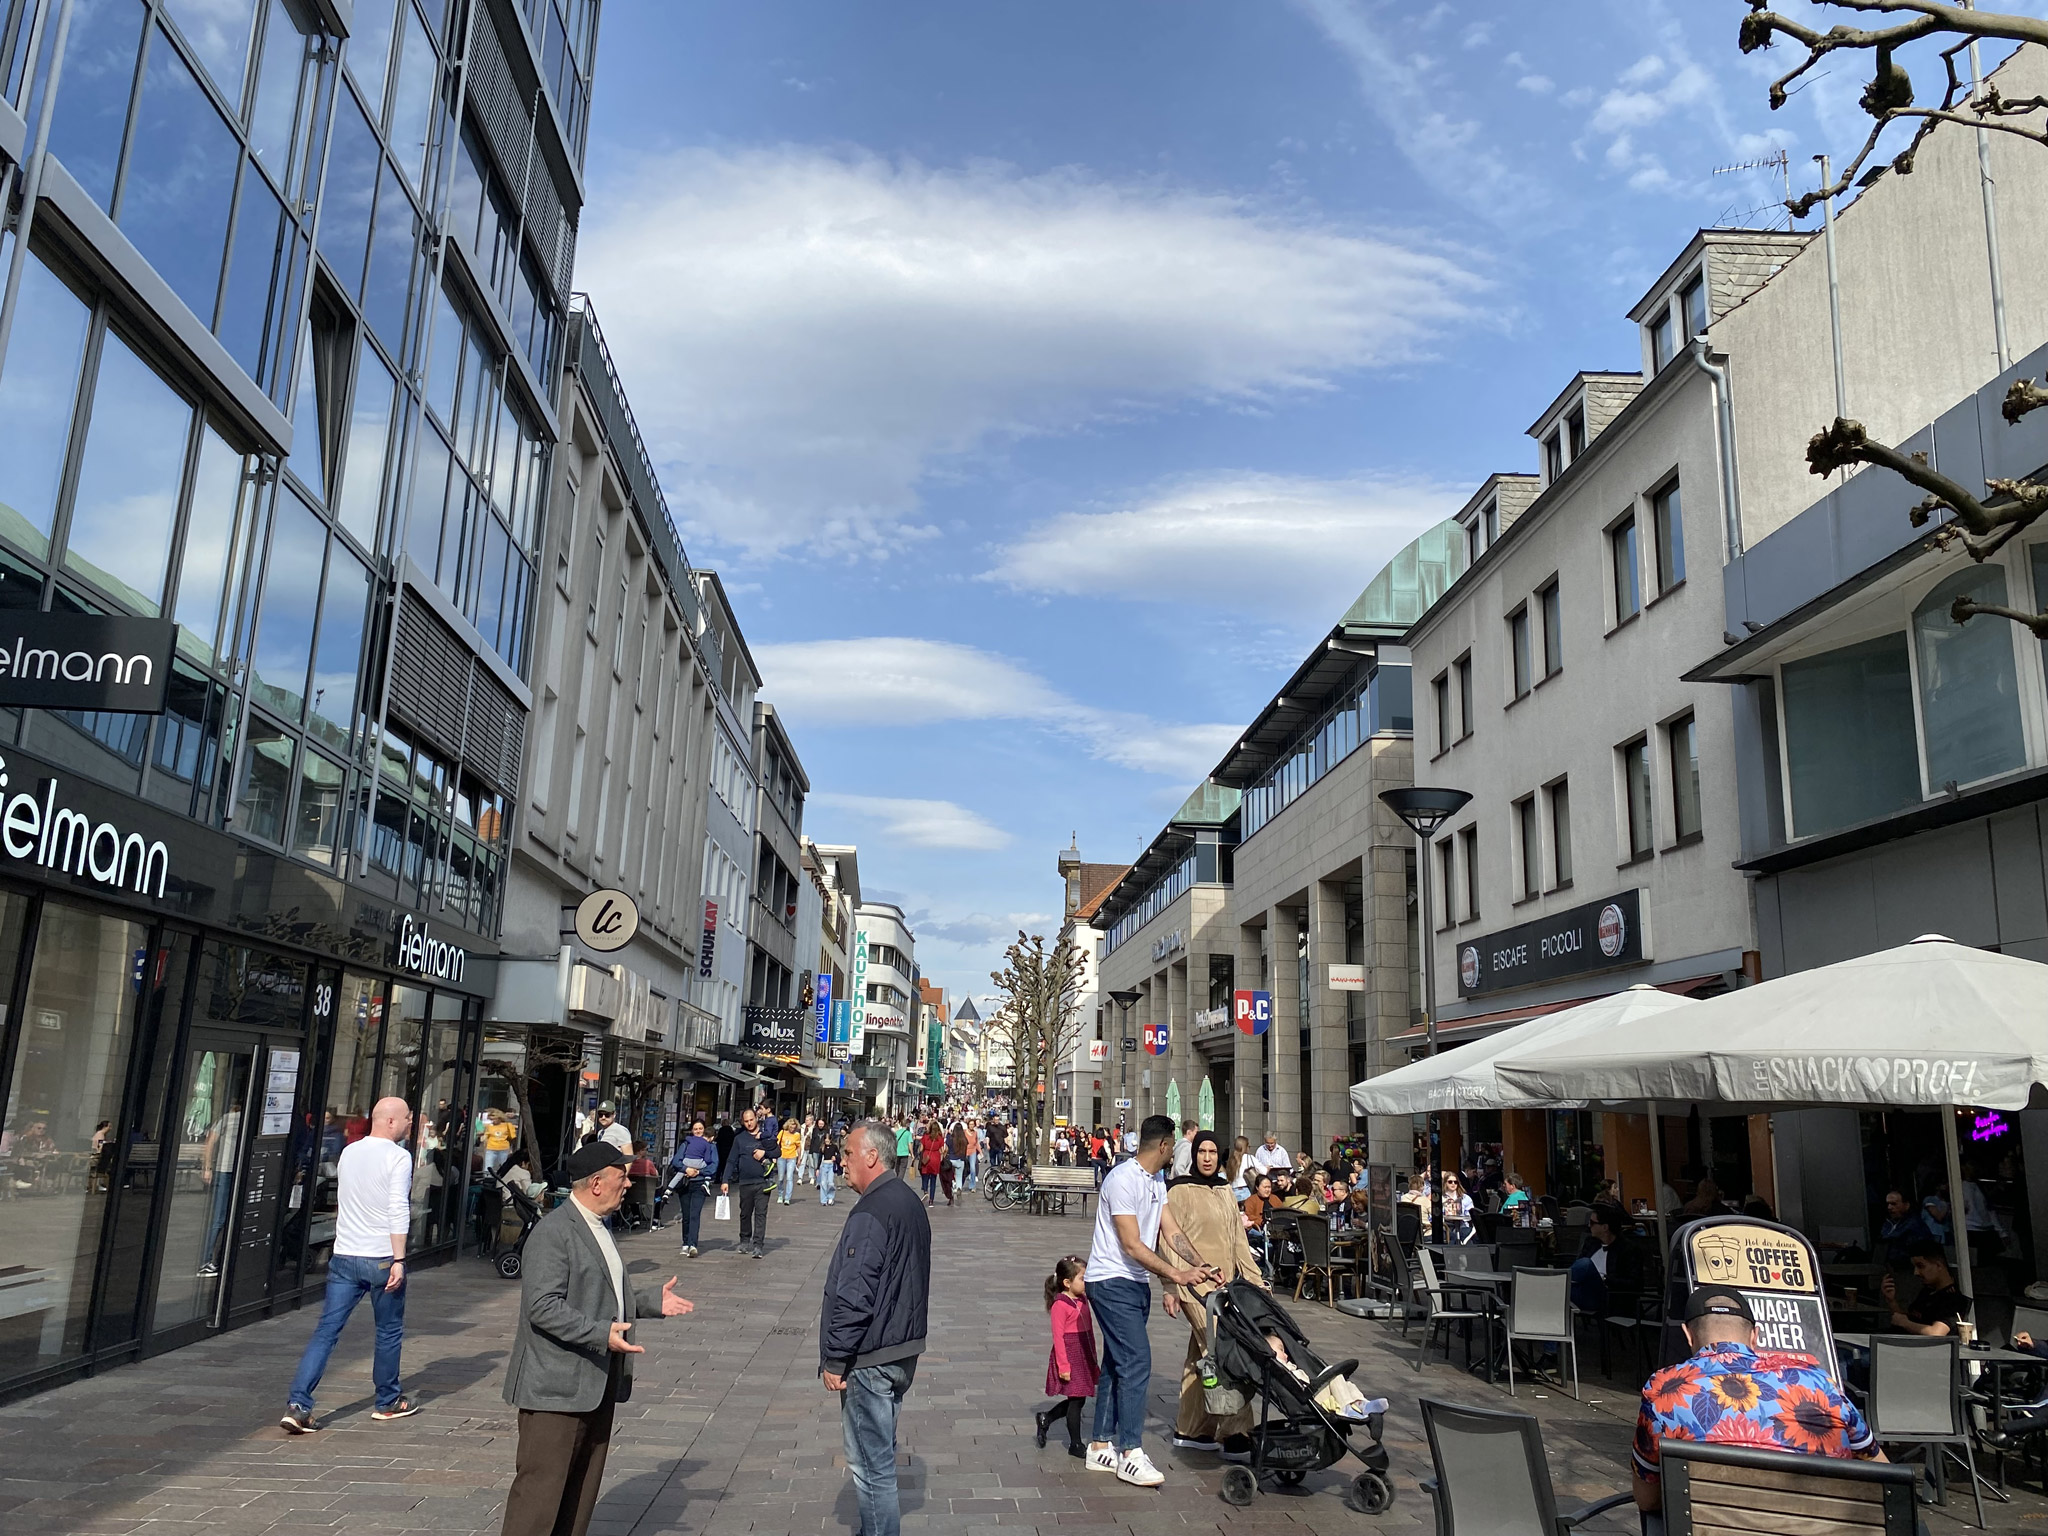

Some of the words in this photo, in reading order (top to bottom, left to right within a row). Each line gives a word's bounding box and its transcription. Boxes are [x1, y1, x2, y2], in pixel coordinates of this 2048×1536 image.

[398, 914, 465, 982] fielmann
[1493, 944, 1528, 971] EISCAFE
[1541, 927, 1582, 959] PICCOLI
[314, 984, 331, 1017] 38
[1237, 999, 1268, 1020] P&C
[752, 1021, 795, 1038] Pollux
[815, 1003, 826, 1039] Apollo
[1144, 1030, 1167, 1045] P&C
[831, 1048, 847, 1057] Tee
[1769, 1056, 1857, 1092] SNACK
[1745, 1247, 1801, 1267] COFFEE
[1749, 1265, 1771, 1284] TO
[1781, 1268, 1805, 1287] GO
[1748, 1298, 1801, 1323] WACH
[1278, 1445, 1315, 1458] hauck
